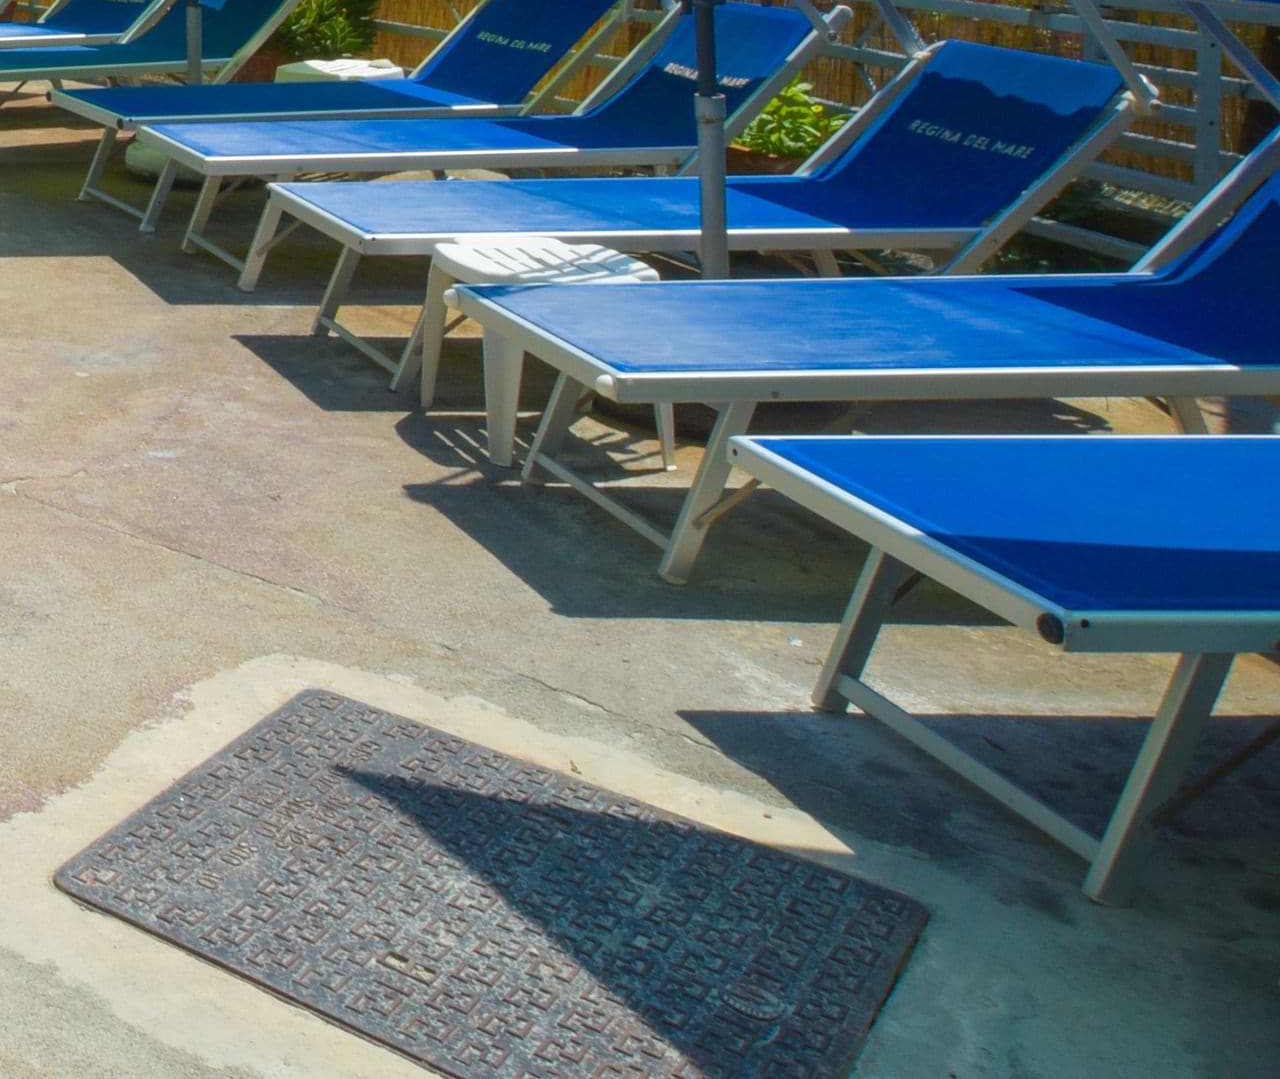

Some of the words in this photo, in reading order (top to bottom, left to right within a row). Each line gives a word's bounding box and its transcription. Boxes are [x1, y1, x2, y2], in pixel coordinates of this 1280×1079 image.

[477, 31, 510, 45] REGINA
[510, 39, 526, 49] DEL
[527, 42, 552, 52] MARE
[663, 62, 699, 80] REGINA
[720, 75, 750, 88] MARE
[908, 120, 963, 143] REGINA
[963, 133, 990, 151] DEL
[990, 140, 1035, 159] MARE
